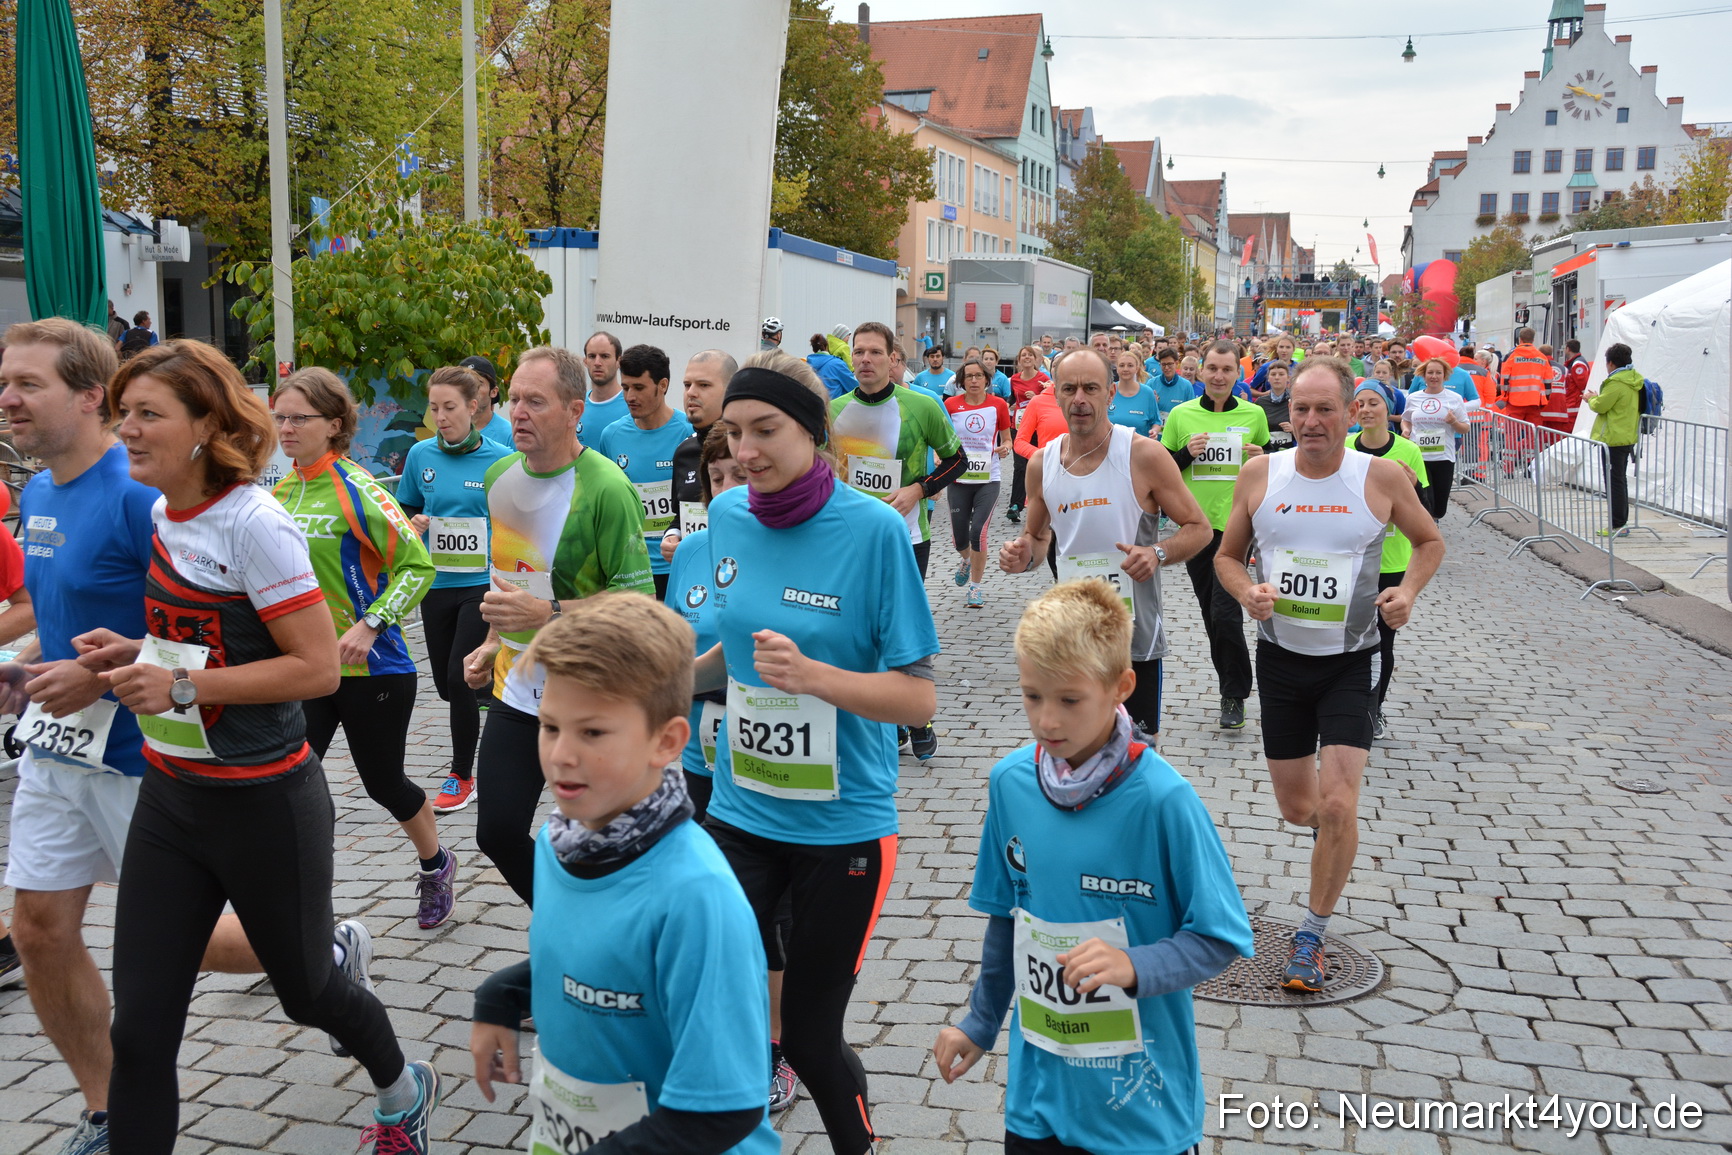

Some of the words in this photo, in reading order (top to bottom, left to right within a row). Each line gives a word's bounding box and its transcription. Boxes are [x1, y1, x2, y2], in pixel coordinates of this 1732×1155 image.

[145, 246, 155, 254] Hut
[163, 246, 179, 254] Mode
[928, 275, 942, 289] D
[596, 311, 731, 331] www.bmw-laufsport.de
[1420, 437, 1440, 445] 5047
[856, 470, 892, 490] 5500
[345, 471, 418, 545] BOCK
[644, 497, 675, 516] 519
[1070, 498, 1112, 510] KLEBL
[1295, 505, 1353, 514] KLEBL
[33, 518, 52, 528] HEUTE
[437, 534, 478, 551] 5003
[1300, 557, 1328, 566] BOCK
[1280, 572, 1338, 599] 5013
[782, 587, 842, 611] BOCK
[1292, 604, 1320, 615] Roland
[755, 697, 799, 707] BOCK
[27, 719, 95, 758] 2352
[739, 716, 811, 757] 5231
[744, 758, 790, 782] Stefanie
[1080, 875, 1156, 900] BOCK
[1039, 930, 1080, 947] BOCK
[563, 974, 644, 1011] BOCK
[1045, 1014, 1090, 1035] Bastian
[1119, 1073, 1148, 1106] September
